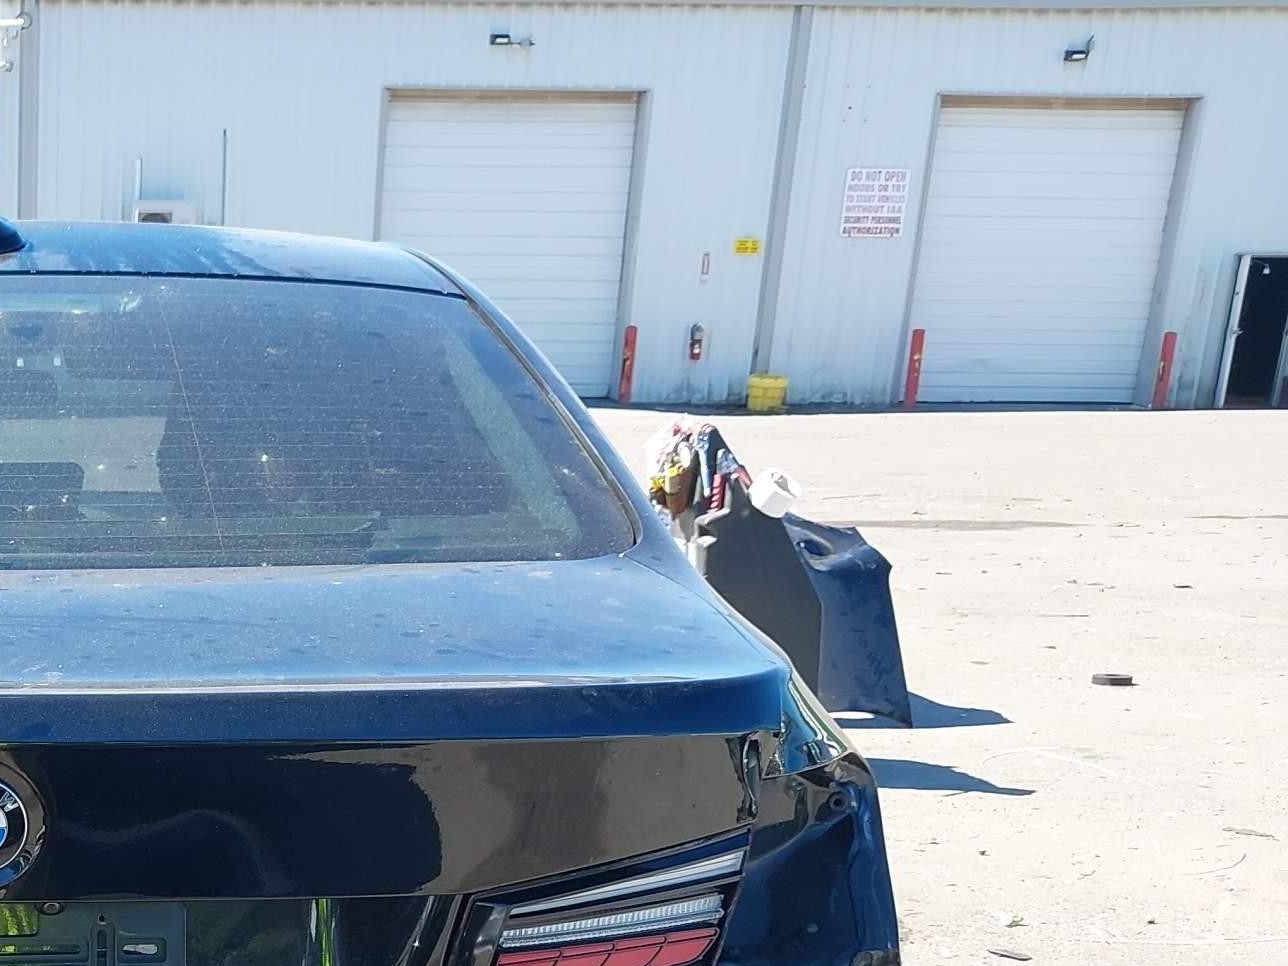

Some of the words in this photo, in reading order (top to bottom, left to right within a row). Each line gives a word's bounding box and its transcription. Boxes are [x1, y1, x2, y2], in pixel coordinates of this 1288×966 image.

[851, 170, 863, 181] DO
[865, 170, 882, 181] NOT
[884, 170, 907, 182] OPEN
[847, 184, 874, 192] HOODS
[877, 184, 889, 192] OR
[892, 184, 907, 192] TRY
[845, 205, 885, 213] WITHOUT
[843, 216, 869, 224] SECURITY
